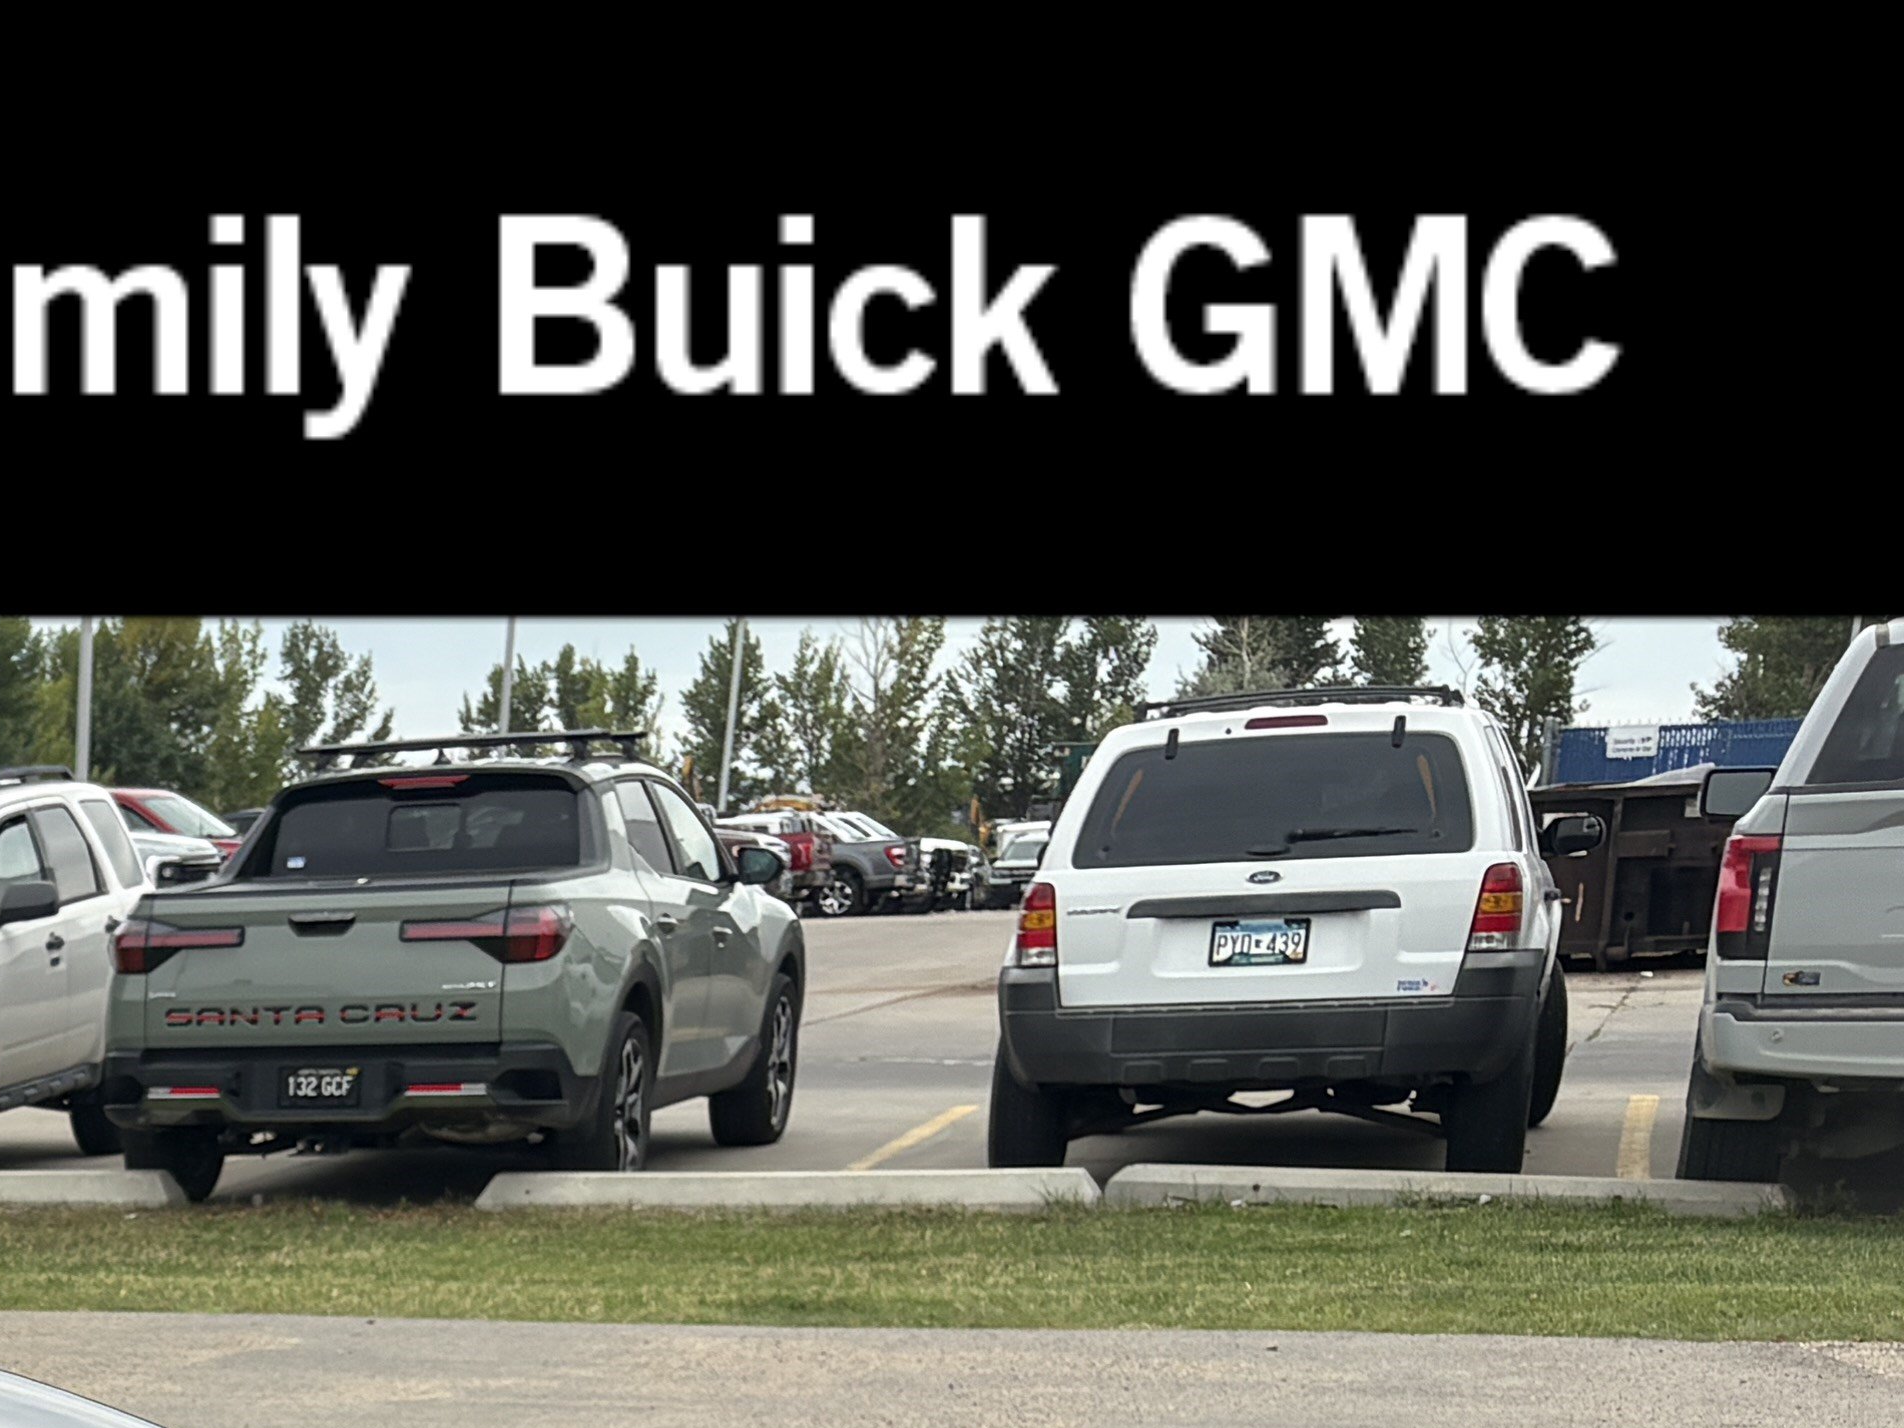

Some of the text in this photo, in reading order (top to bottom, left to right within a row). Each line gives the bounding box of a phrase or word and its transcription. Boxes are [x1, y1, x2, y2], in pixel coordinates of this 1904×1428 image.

[1266, 932, 1302, 955] 439
[164, 1001, 478, 1028] SANTA CRUZ
[288, 1075, 354, 1097] 132 GCF
